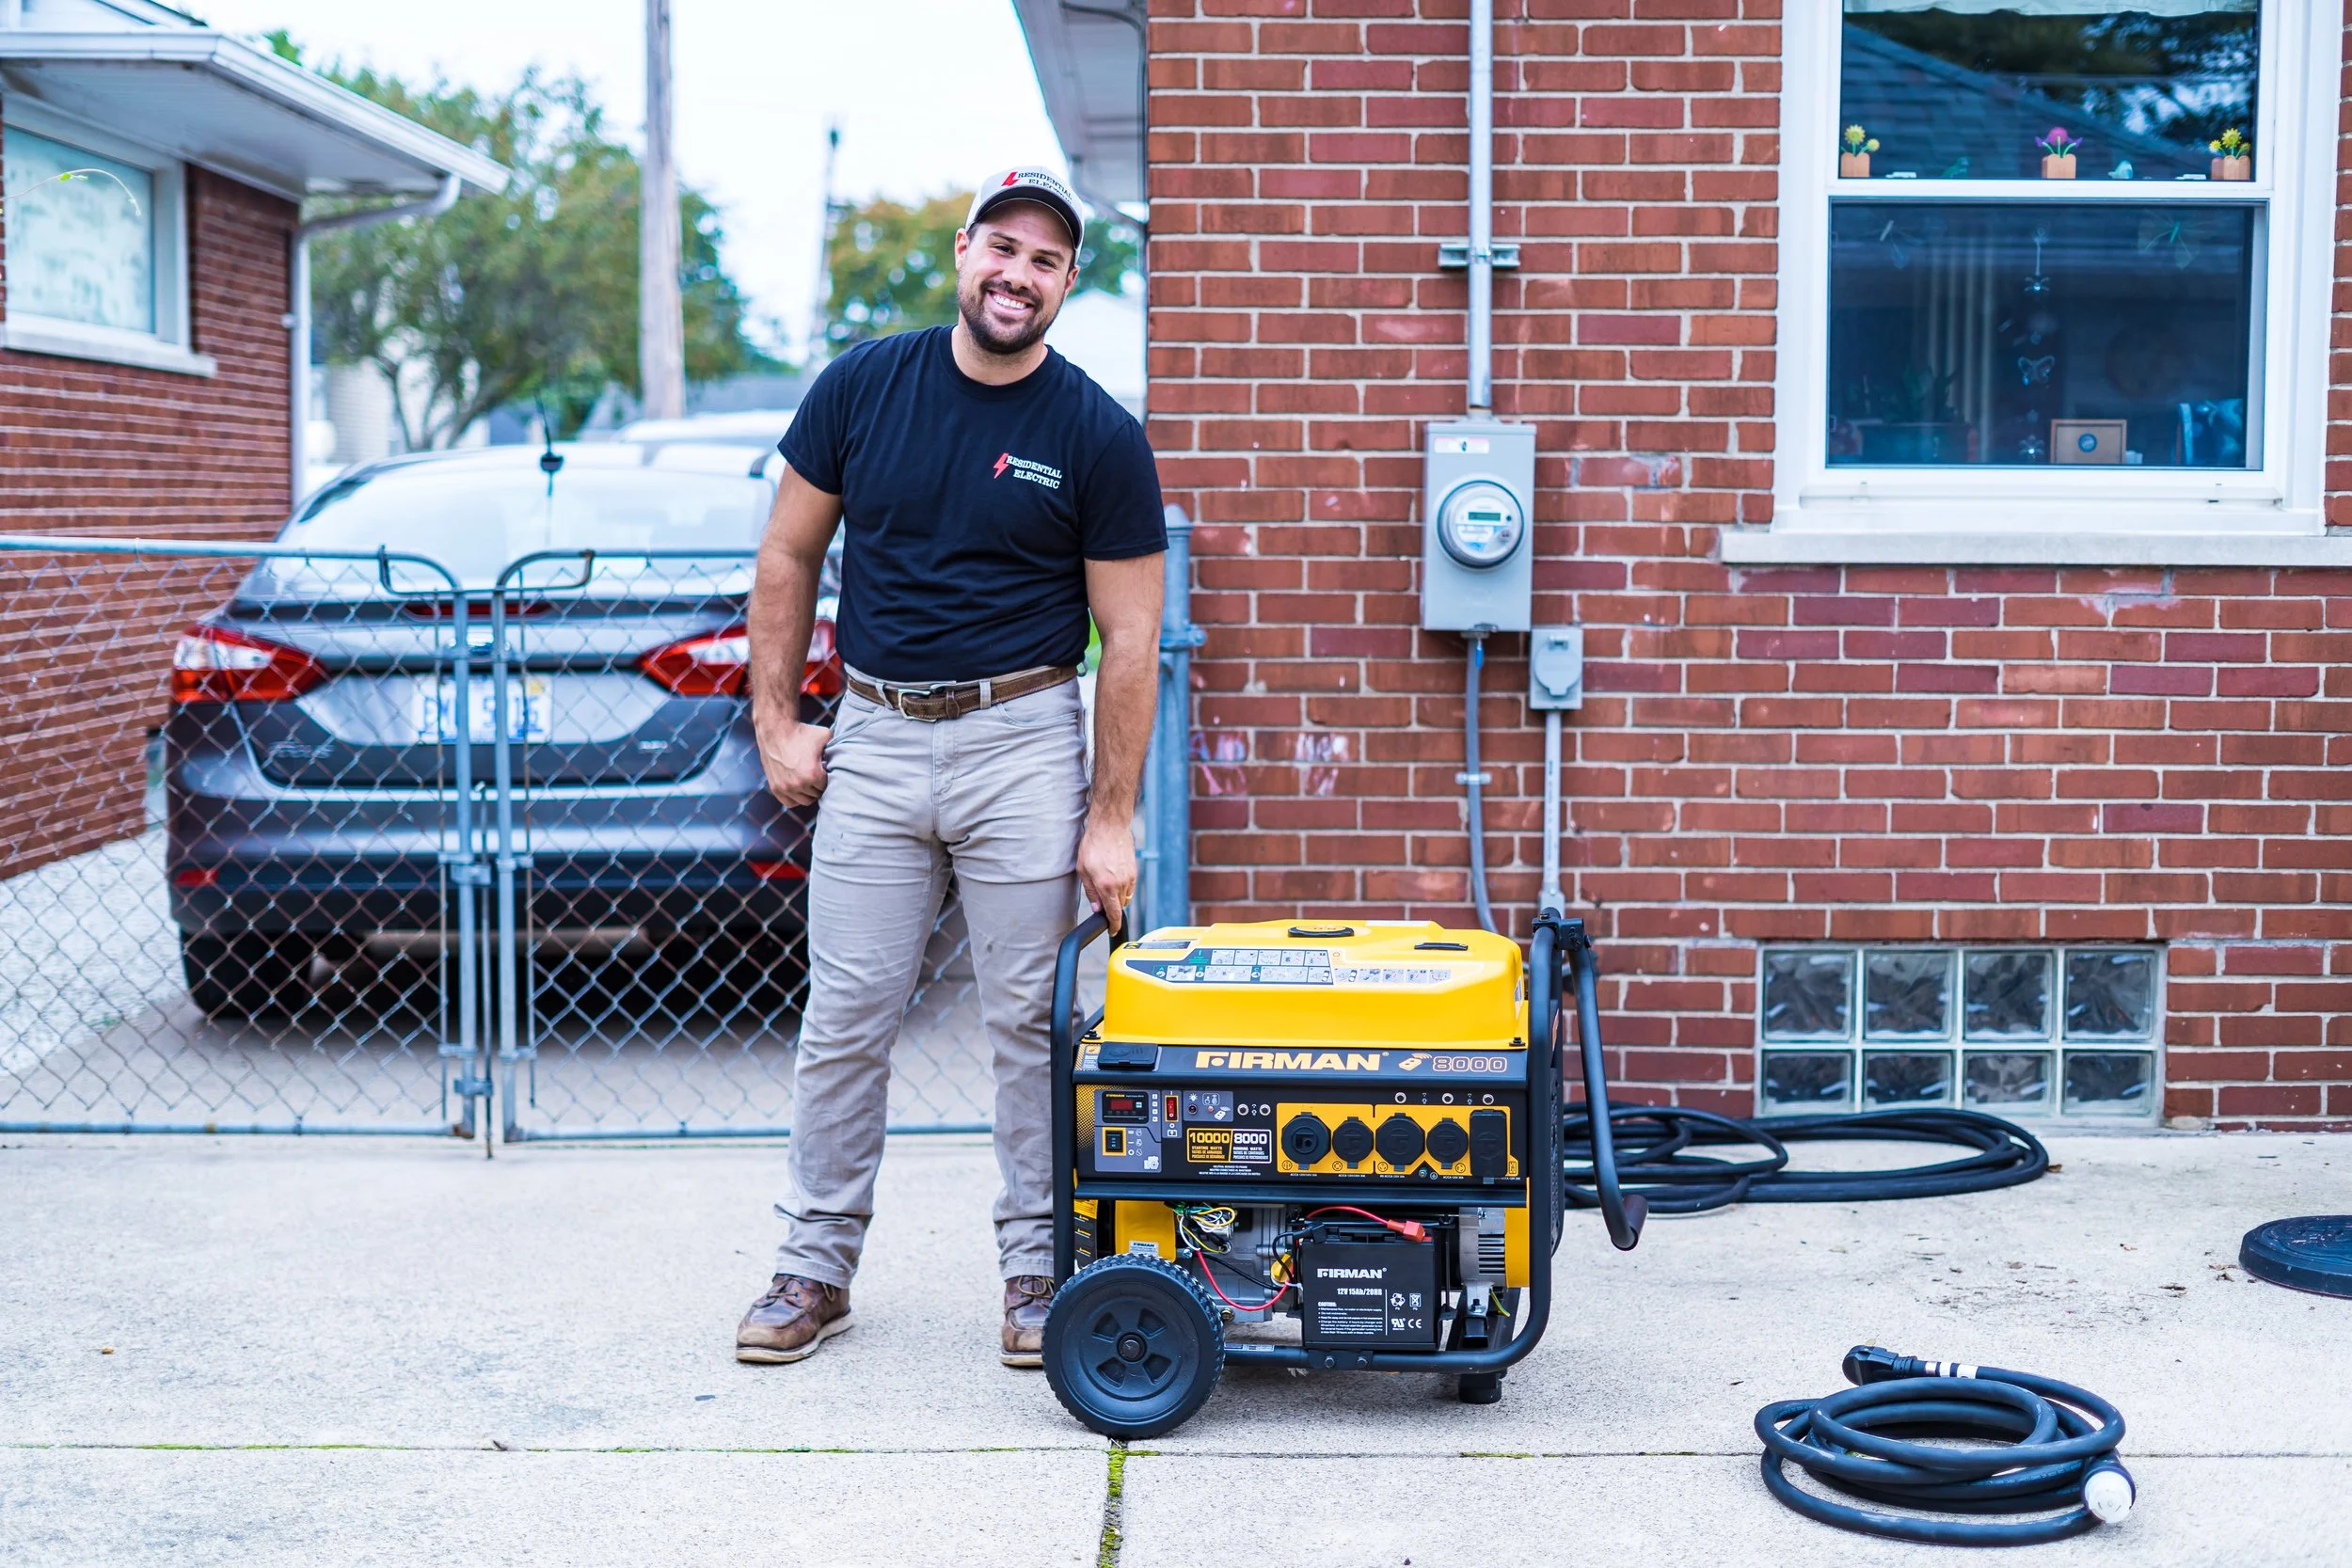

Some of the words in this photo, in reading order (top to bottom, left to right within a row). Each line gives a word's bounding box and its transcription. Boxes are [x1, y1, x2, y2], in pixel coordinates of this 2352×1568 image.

[1018, 172, 1072, 199] RESIDENTIAL
[1006, 455, 1062, 479] RESIDENTIAL
[1013, 469, 1060, 489] ELECTRIC
[1195, 1051, 1381, 1071] FIRMAN
[1432, 1056, 1508, 1072] 8000
[1189, 1132, 1230, 1144] 10000
[1233, 1132, 1267, 1144] 8000
[1316, 1268, 1383, 1279] FIRMAN
